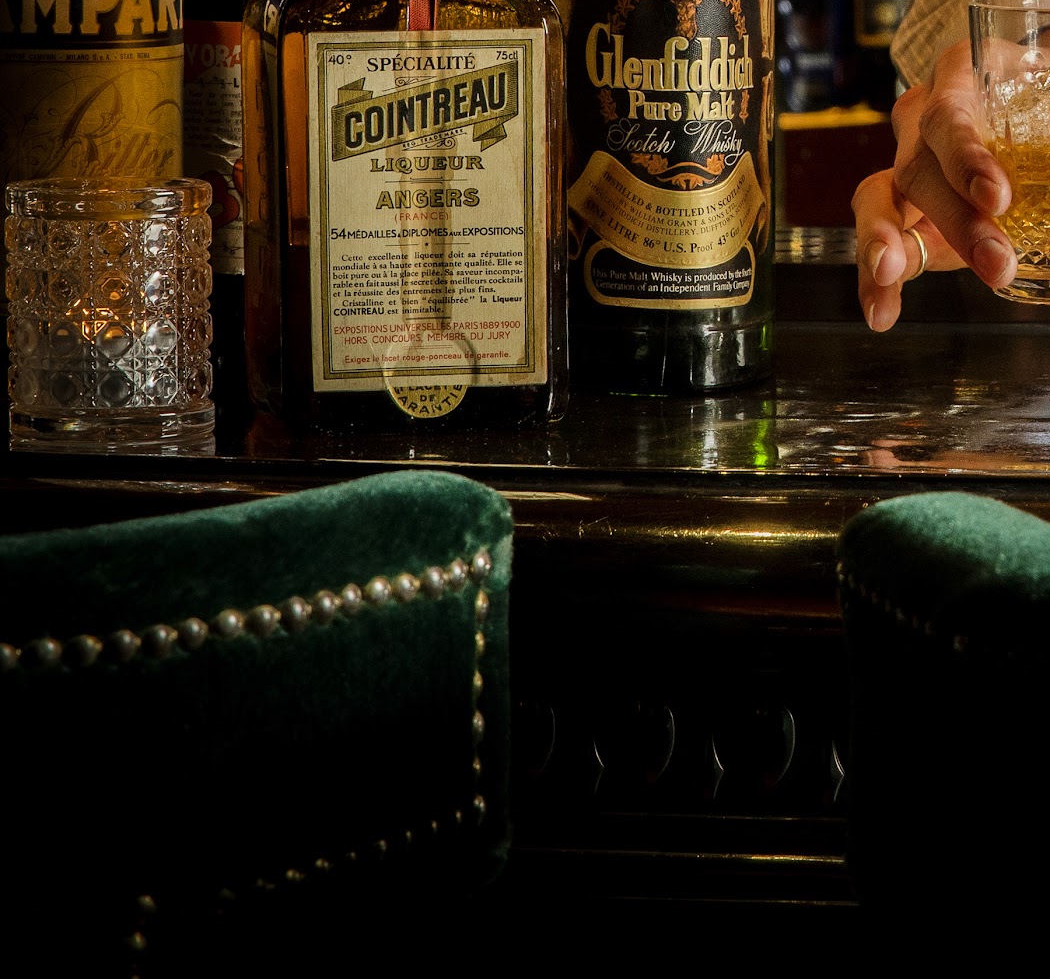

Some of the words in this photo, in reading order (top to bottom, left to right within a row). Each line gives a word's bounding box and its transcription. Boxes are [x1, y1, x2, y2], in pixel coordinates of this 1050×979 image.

[366, 52, 476, 73] SPÉCIALITÉ
[585, 22, 754, 92] Glenfiddich
[344, 72, 506, 149] COINTREAU
[627, 89, 682, 121] Pure
[685, 91, 736, 121] Malt
[606, 117, 676, 154] Scotch
[683, 120, 745, 166] Whisky
[370, 155, 486, 175] LIQUEUR
[376, 188, 481, 210] ANGERS
[603, 170, 645, 207] DISTILLED
[645, 202, 653, 211] &
[655, 205, 705, 217] BOTTLED
[706, 203, 717, 214] IN
[717, 174, 746, 210] SCOTLAND
[394, 210, 449, 223] (FRANCE)
[630, 205, 665, 225] WILLIAM
[667, 219, 698, 227] GRANT
[700, 218, 706, 226] &
[707, 211, 725, 224] SONS
[331, 228, 347, 240] 54
[347, 228, 397, 239] MÉDAILLES
[402, 226, 448, 238] DIPLOMES
[462, 226, 524, 237] EXPOSITIONS
[607, 217, 640, 244] LITRE
[642, 236, 661, 249] 86°
[663, 241, 687, 253] U.S.
[690, 241, 714, 253] Proof
[717, 232, 729, 247] 43°
[341, 254, 363, 262] Cette
[368, 252, 408, 261] excellente
[414, 251, 444, 261] liqueur
[448, 250, 464, 259] doit
[480, 249, 523, 259] réputation
[332, 262, 370, 271] mondiale
[390, 261, 412, 269] haute
[423, 260, 462, 268] constante
[464, 259, 495, 268] qualité.
[497, 258, 512, 266] Elle
[332, 272, 349, 280] boit
[400, 269, 419, 279] glace
[421, 268, 443, 278] pilée.
[445, 268, 454, 276] Sa
[485, 267, 523, 276] incompa-
[610, 269, 627, 280] Pure
[629, 270, 648, 281] Malt
[650, 271, 682, 283] Whisky
[684, 272, 692, 281] is
[694, 271, 728, 284] produced
[728, 270, 734, 283] by
[332, 280, 353, 289] rable
[366, 279, 379, 288] fait
[380, 279, 400, 287] aussi
[411, 278, 434, 286] secret
[435, 277, 448, 285] des
[450, 277, 486, 285] meilleurs
[488, 276, 523, 284] cocktails
[595, 280, 636, 291] Generation
[637, 280, 646, 290] of
[647, 283, 658, 291] an
[660, 282, 711, 294] Independent
[712, 280, 733, 293] Family
[332, 290, 341, 298] et
[344, 289, 352, 297] la
[353, 289, 384, 297] réussite
[386, 287, 400, 296] des
[403, 286, 442, 295] entremets
[444, 286, 456, 294] les
[459, 285, 475, 295] plus
[478, 285, 496, 293] fins.
[342, 298, 384, 307] Cristalline
[401, 297, 419, 306] bien
[480, 295, 487, 303] la
[492, 295, 523, 304] Liqueur
[333, 306, 385, 317] COINTREAU
[402, 305, 444, 315] inimitable.
[334, 324, 388, 335] EXPOSITIONS
[390, 322, 452, 333] UNIVERSELLES
[453, 321, 479, 331] PARIS
[479, 320, 500, 329] 1889
[500, 320, 521, 329] 1900
[344, 335, 368, 345] HORS
[372, 333, 423, 344] CONCOURS,
[427, 332, 466, 342] MEMBRE
[470, 331, 484, 341] DU
[487, 331, 511, 340] JURY
[344, 355, 371, 365] Exigez
[381, 354, 400, 362] lacet
[402, 353, 462, 363] rouge-ponceau
[476, 350, 511, 361] garantie.
[419, 394, 436, 402] DE
